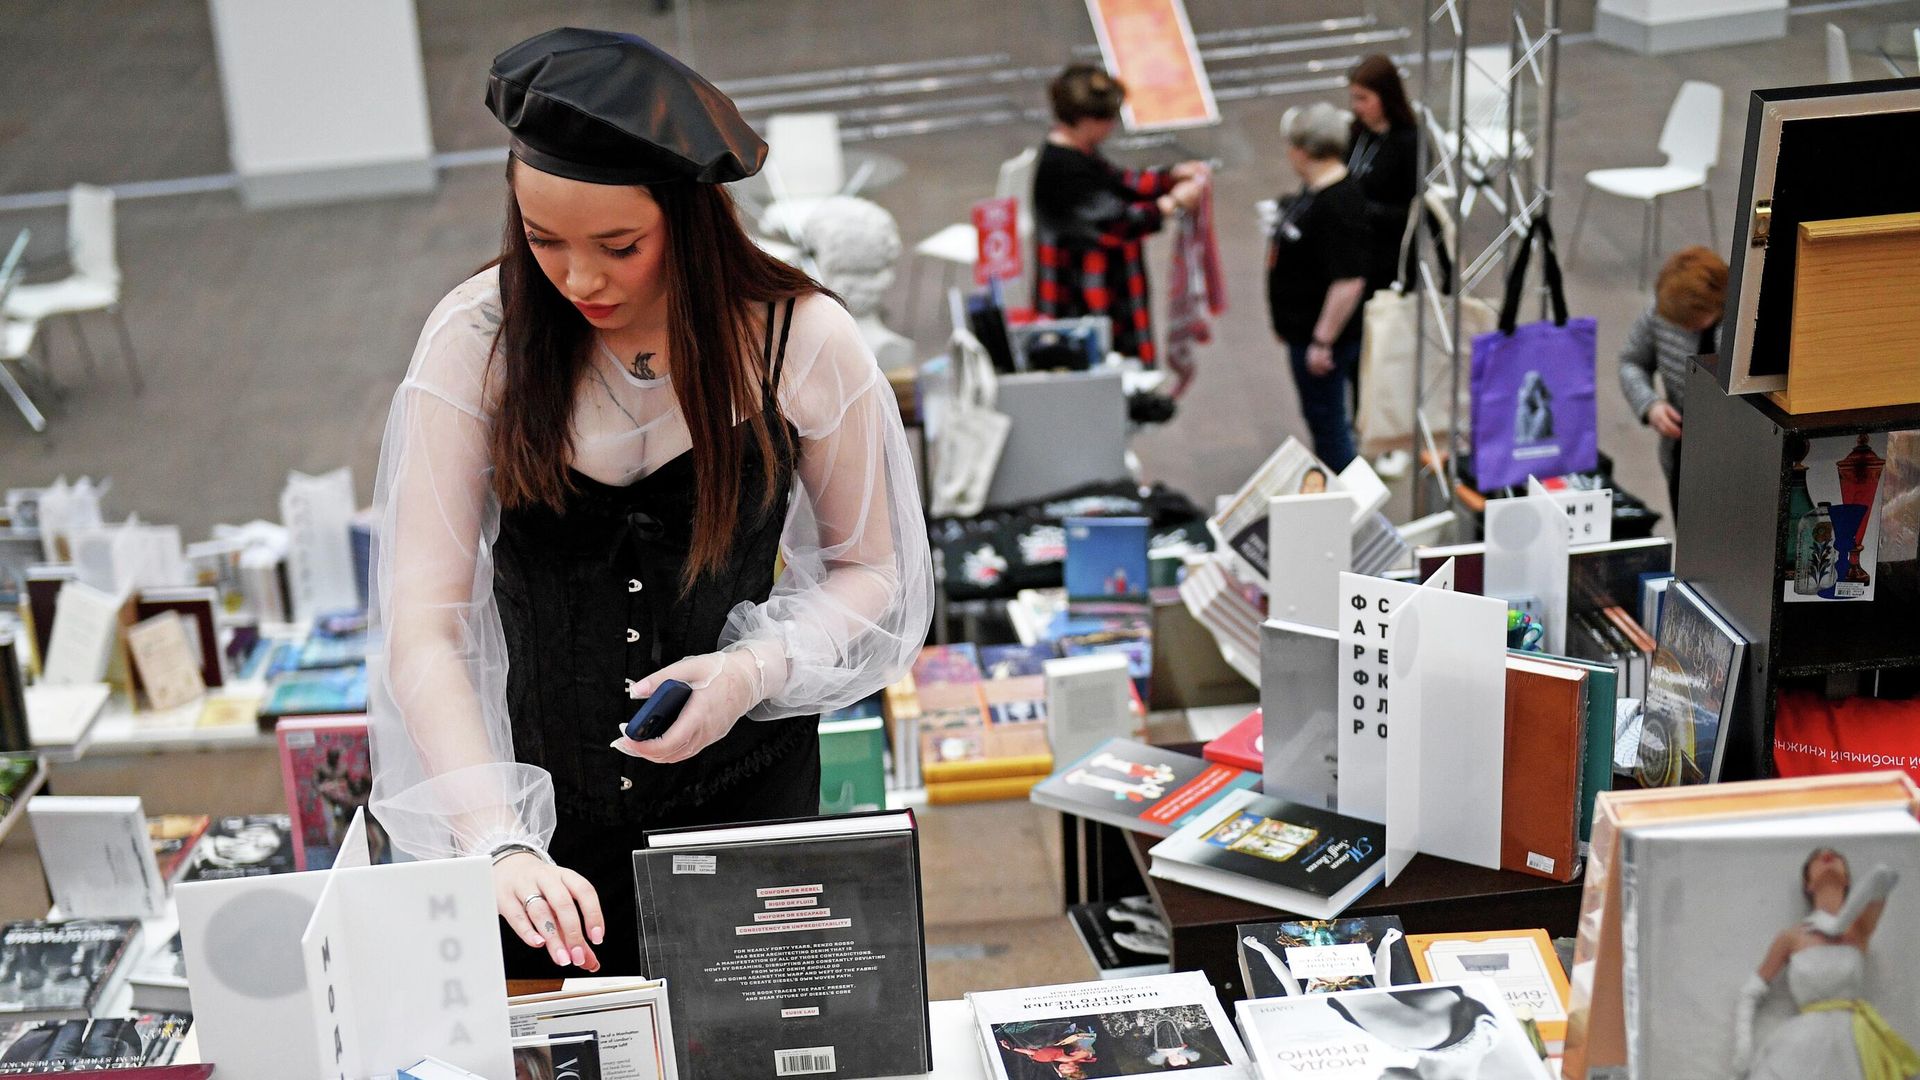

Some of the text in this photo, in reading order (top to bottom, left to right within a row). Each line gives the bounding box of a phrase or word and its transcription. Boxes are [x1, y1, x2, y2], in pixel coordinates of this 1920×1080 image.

[1351, 594, 1369, 734] ФАРФОР
[1377, 598, 1389, 739] СТЕКЛО
[1830, 750, 1905, 768] любимый
[791, 921, 848, 929] UNPREDICTABILITY
[428, 894, 474, 1045] МОДА
[321, 935, 344, 1080] МОД
[1023, 992, 1158, 1009] НИЖНЕГО БЕЛЬЯ
[1060, 999, 1132, 1010] ИСТОРИЯ
[1278, 1043, 1369, 1060] КИНО В
[1290, 1057, 1366, 1072] МОДА
